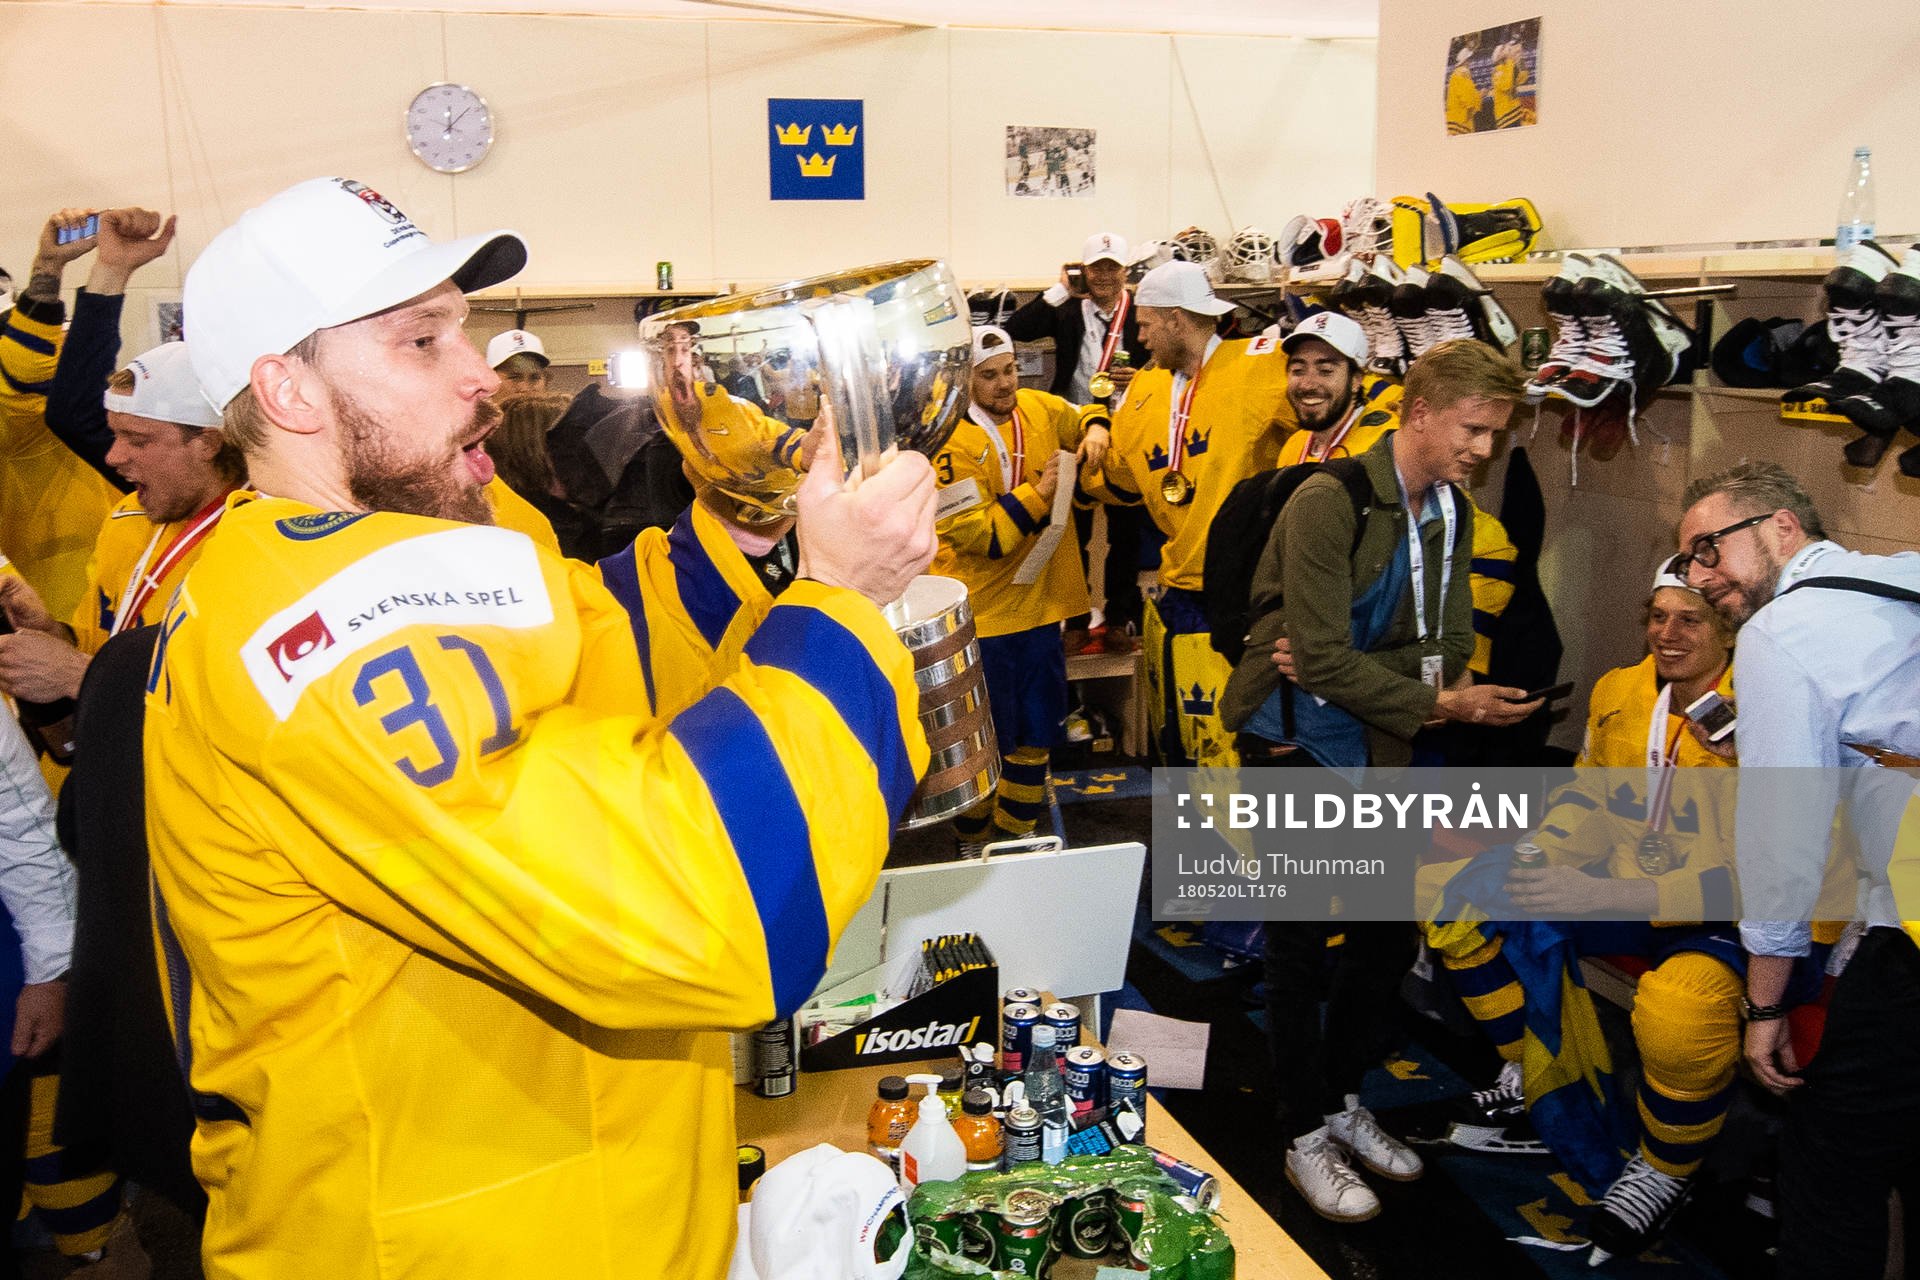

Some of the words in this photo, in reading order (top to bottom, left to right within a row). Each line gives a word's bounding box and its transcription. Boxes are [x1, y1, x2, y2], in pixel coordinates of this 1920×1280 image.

[347, 590, 461, 632] SVENSKA
[465, 587, 524, 607] SPEL
[352, 634, 522, 788] 31
[861, 1020, 971, 1055] isostar
